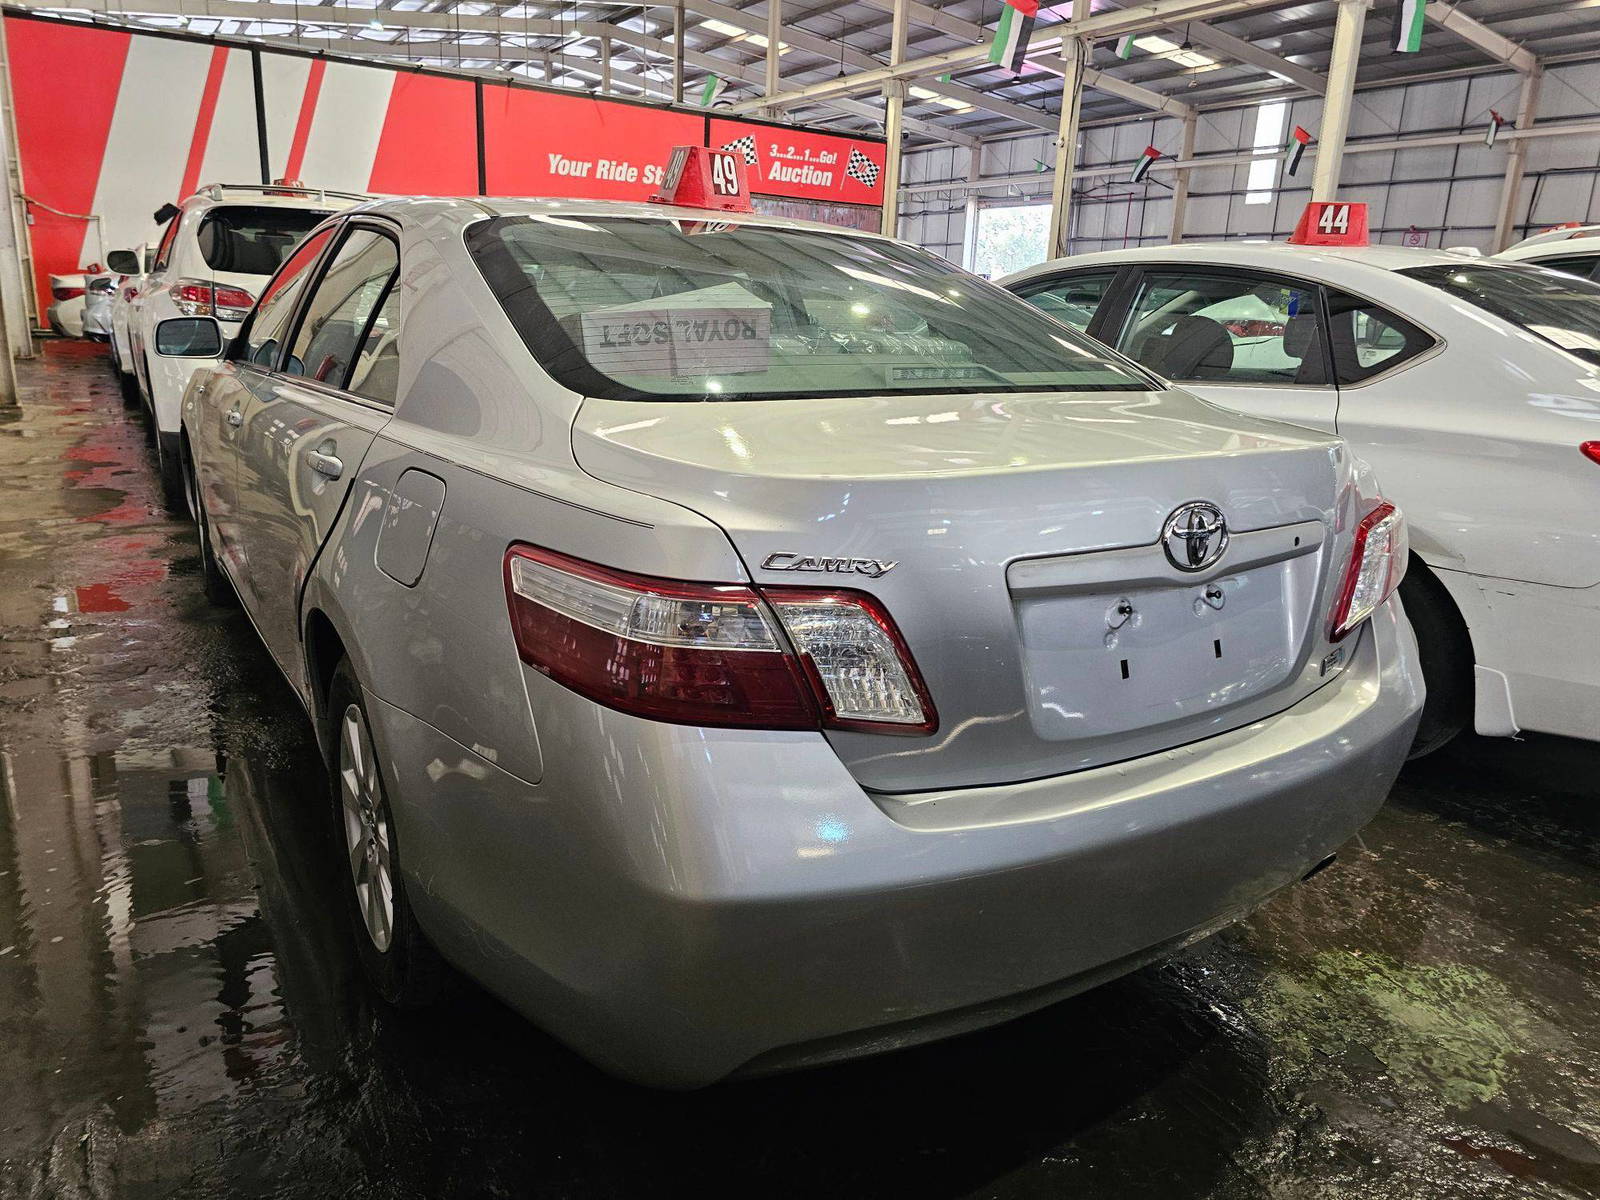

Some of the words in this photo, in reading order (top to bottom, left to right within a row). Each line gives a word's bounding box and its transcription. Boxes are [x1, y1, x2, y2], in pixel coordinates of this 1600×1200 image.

[548, 153, 593, 178] Your
[595, 159, 639, 183] Ride
[642, 164, 665, 186] St
[713, 154, 739, 195] 49
[768, 161, 833, 187] Auction
[1319, 204, 1350, 234] 44
[600, 321, 671, 348] SOFT
[676, 318, 757, 343] ROYAL
[760, 551, 900, 578] CAMRY
